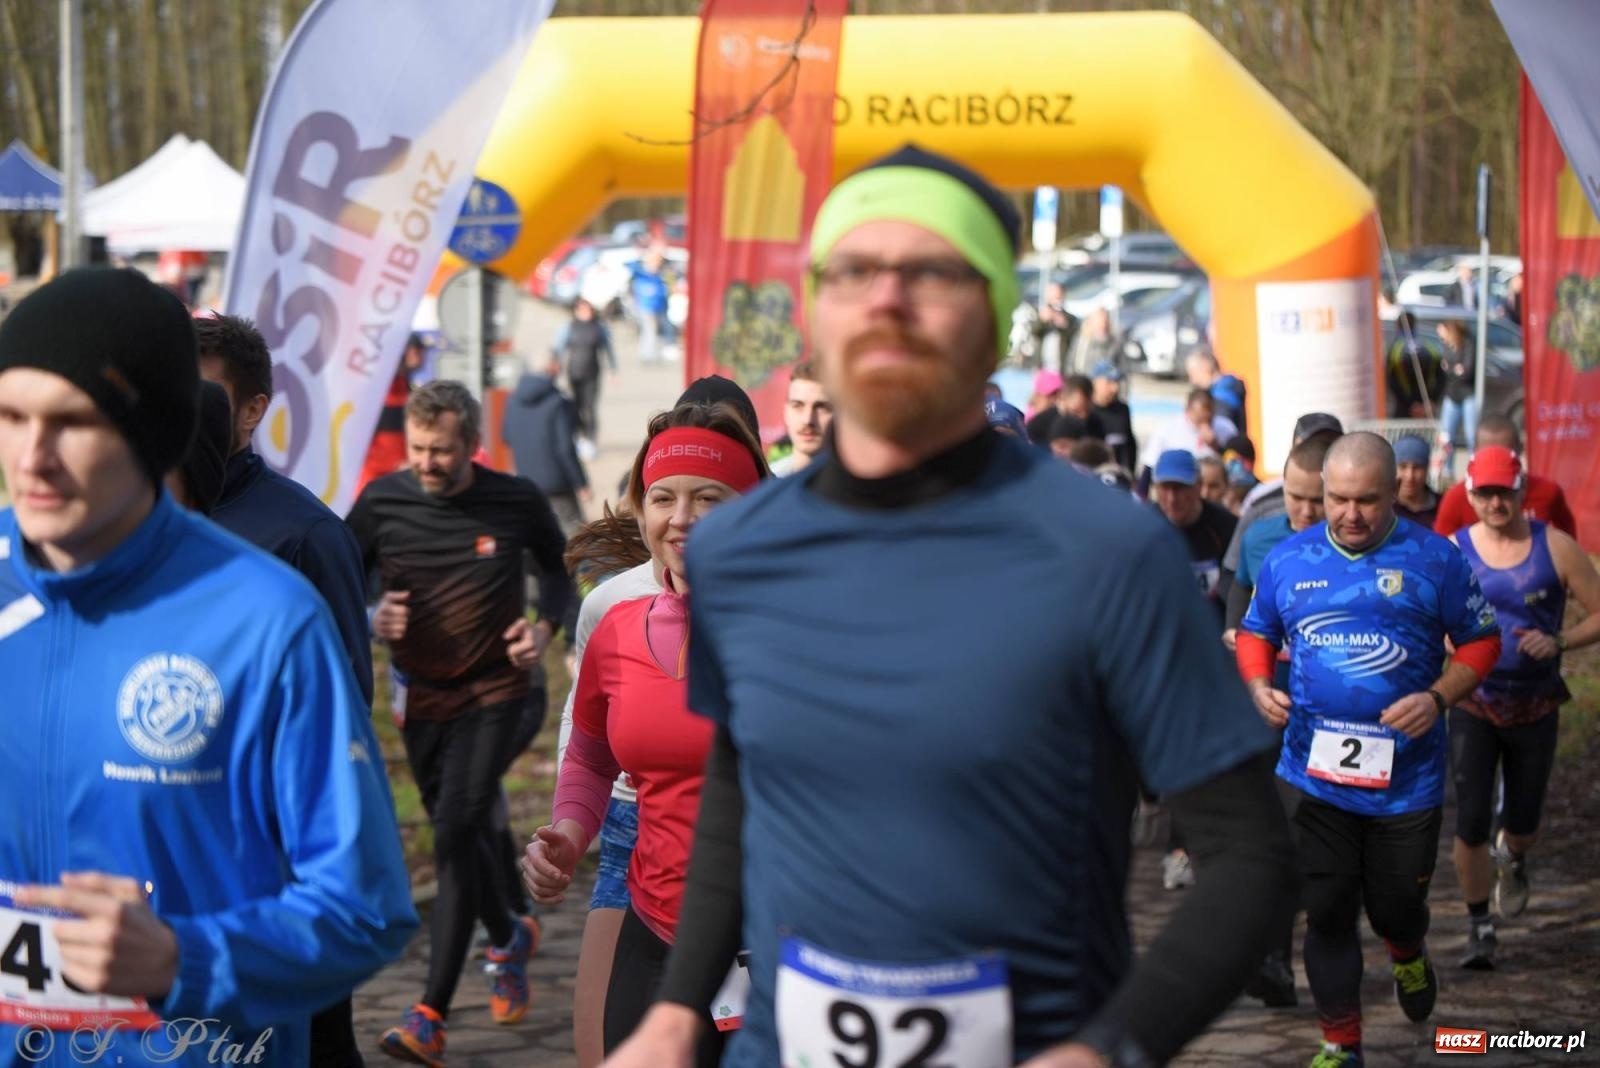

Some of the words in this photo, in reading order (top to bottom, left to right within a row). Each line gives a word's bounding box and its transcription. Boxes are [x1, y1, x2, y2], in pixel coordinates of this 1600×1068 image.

[868, 92, 1075, 126] RACIBÓRZ
[346, 150, 457, 379] RACIBÓRZ
[1340, 738, 1362, 769] 2
[829, 1001, 951, 1068] 92
